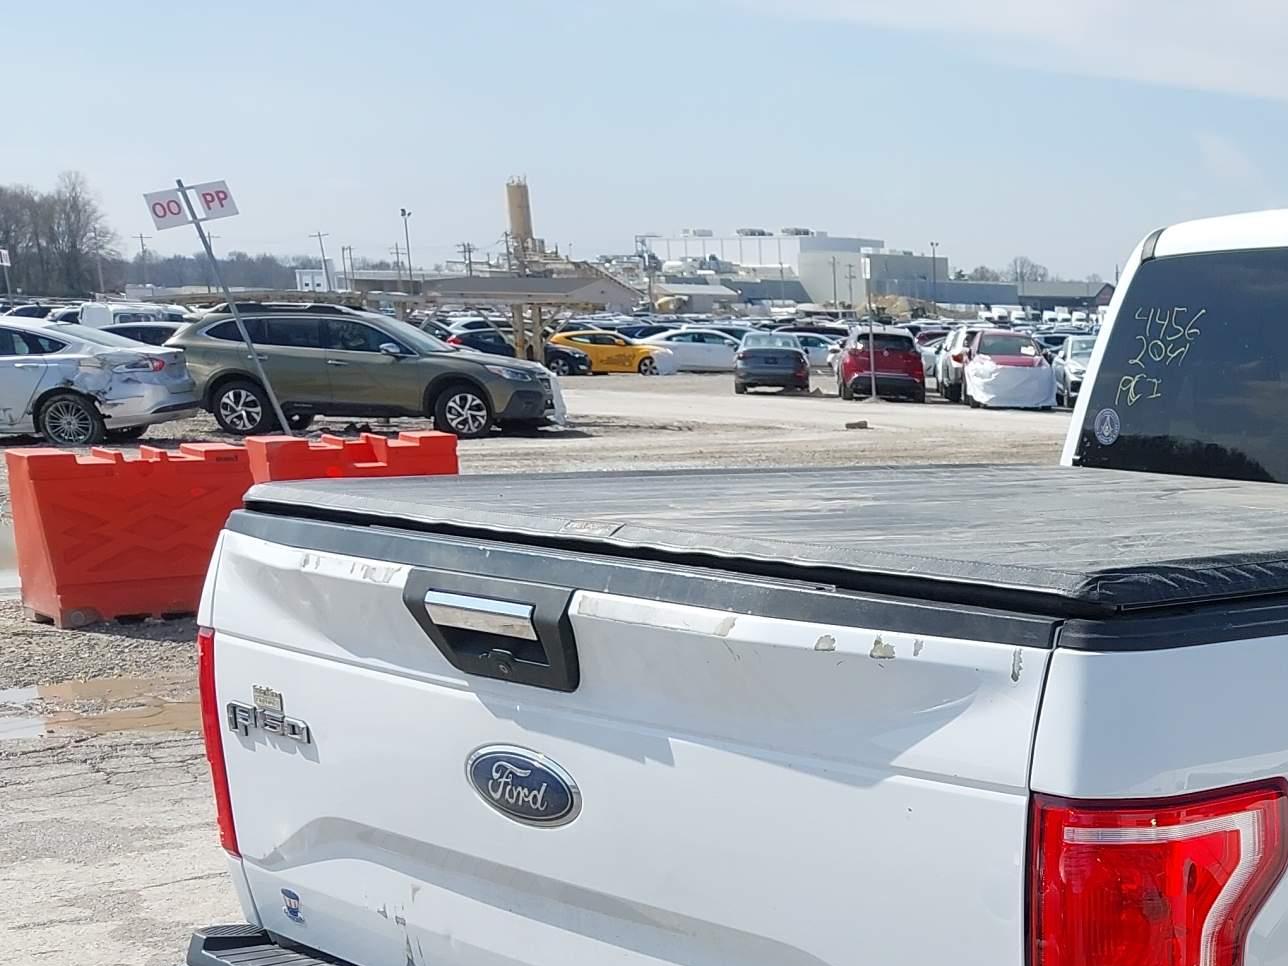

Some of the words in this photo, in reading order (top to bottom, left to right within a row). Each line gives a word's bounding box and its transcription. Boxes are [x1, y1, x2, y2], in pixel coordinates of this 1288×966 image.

[202, 190, 228, 210] PP
[1134, 307, 1207, 341] 4456
[488, 760, 548, 811] Ford
